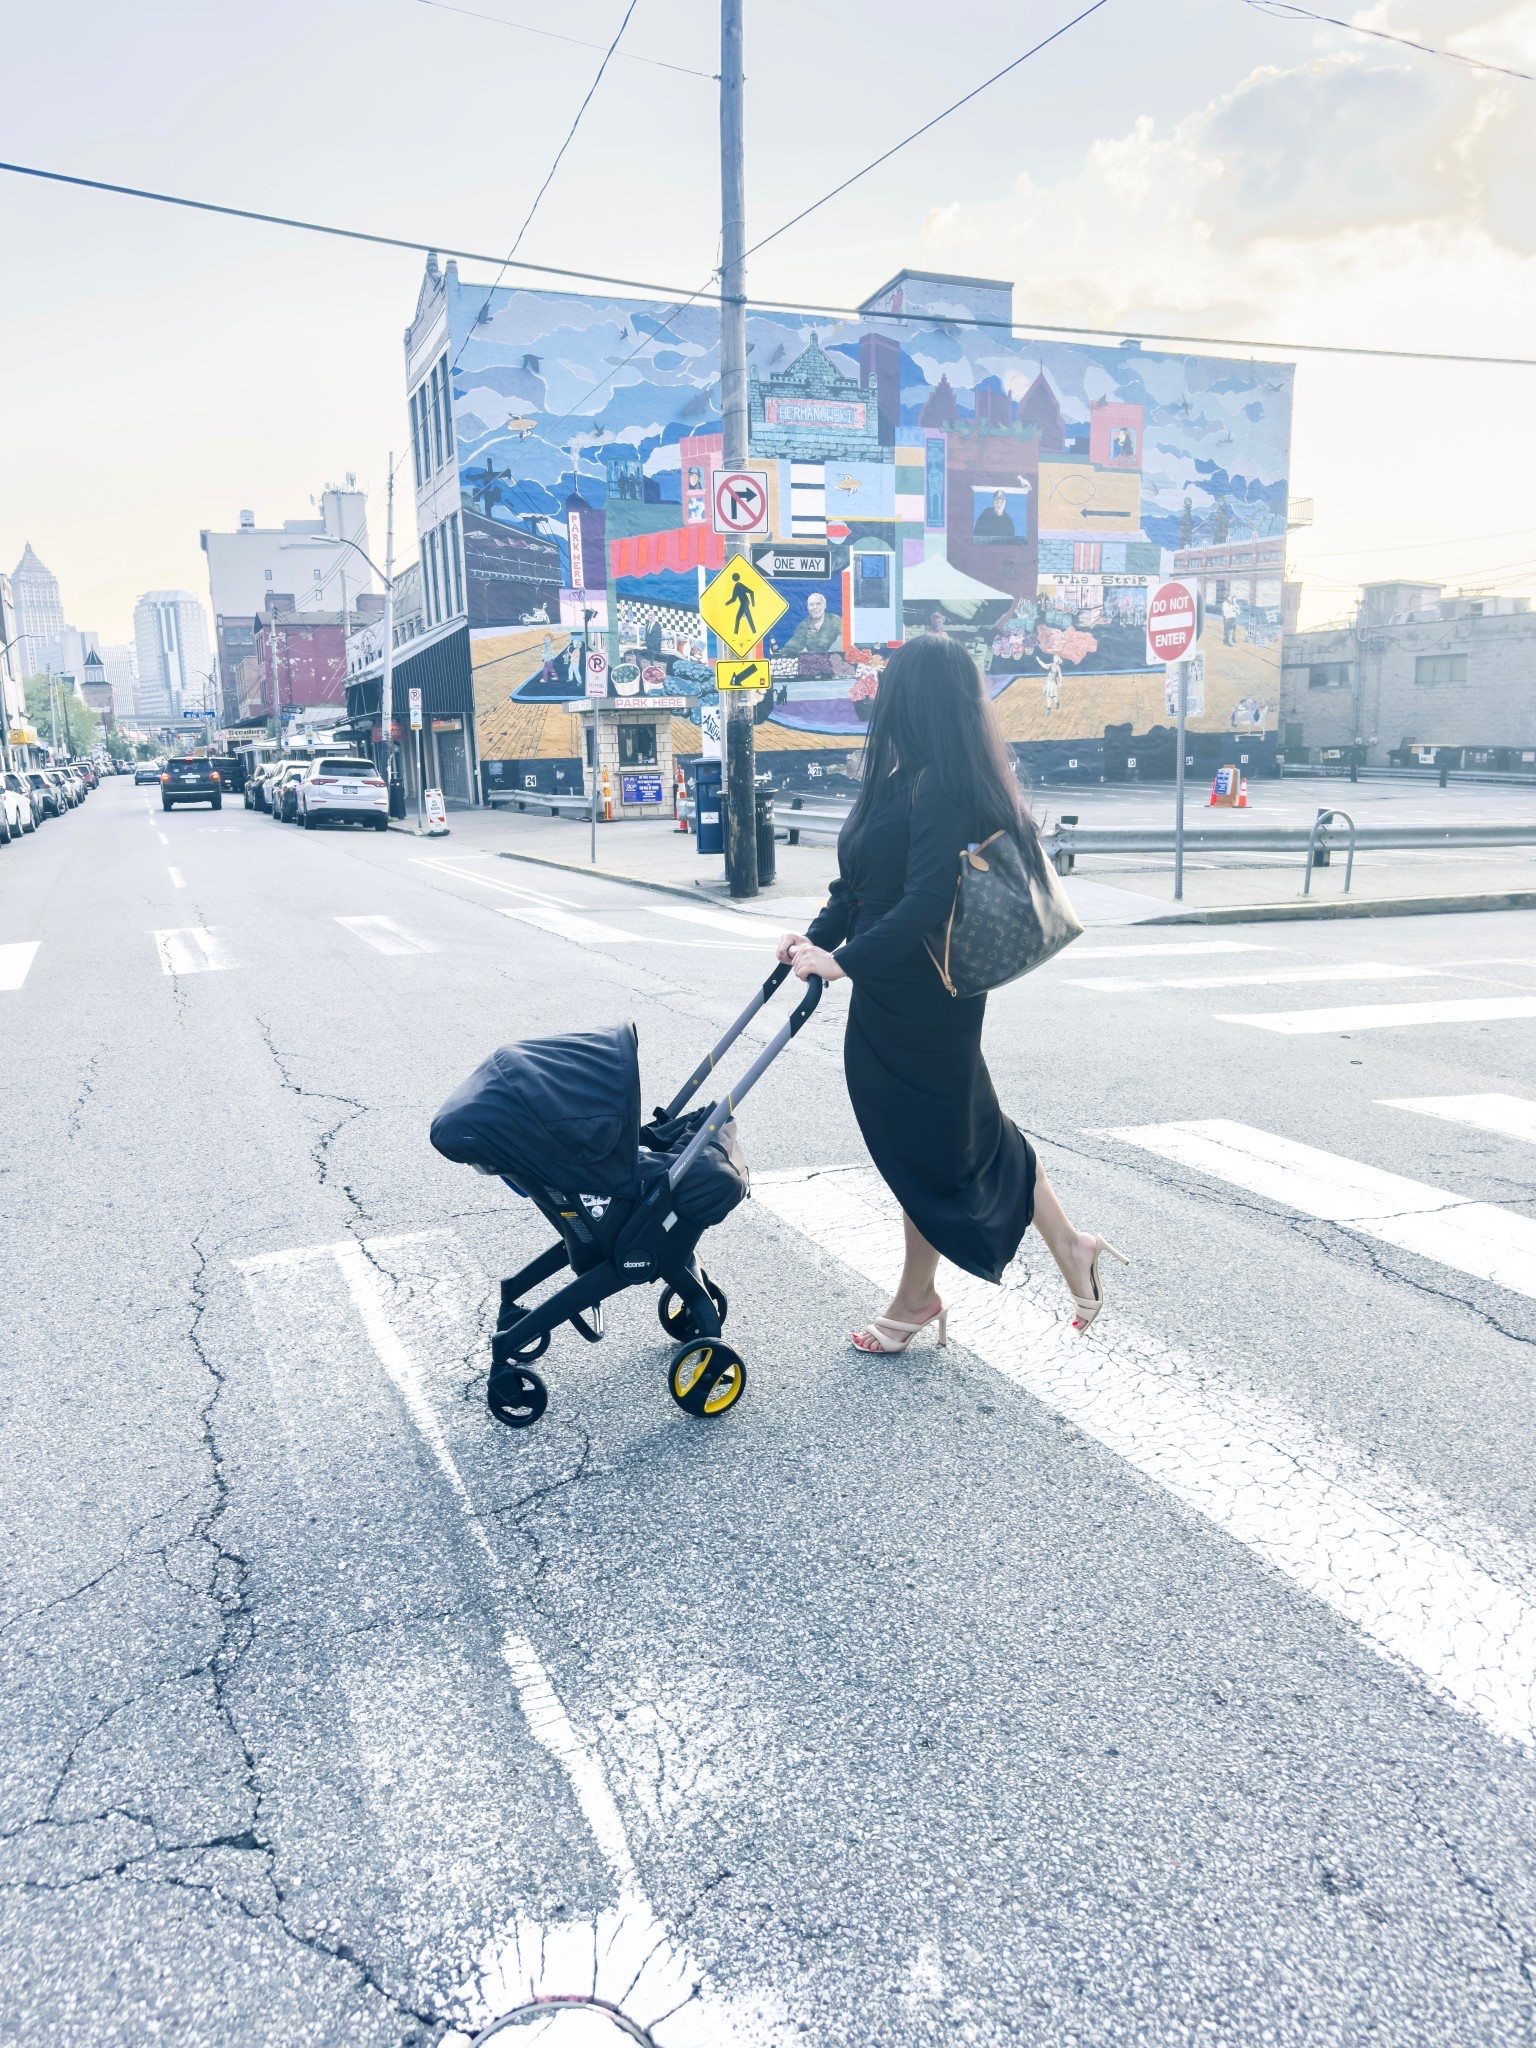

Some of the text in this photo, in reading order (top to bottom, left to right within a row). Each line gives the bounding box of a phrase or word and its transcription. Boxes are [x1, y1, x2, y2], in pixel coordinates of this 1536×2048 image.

[779, 405, 853, 424] HERMANOWSKI
[571, 515, 581, 586] PARK HERE
[774, 557, 822, 570] ONE WAY
[1053, 575, 1146, 586] The Strip
[1152, 596, 1190, 614] DO NOT
[1155, 631, 1186, 648] ENTER
[616, 698, 683, 707] PARK HERE
[526, 776, 536, 786] 24
